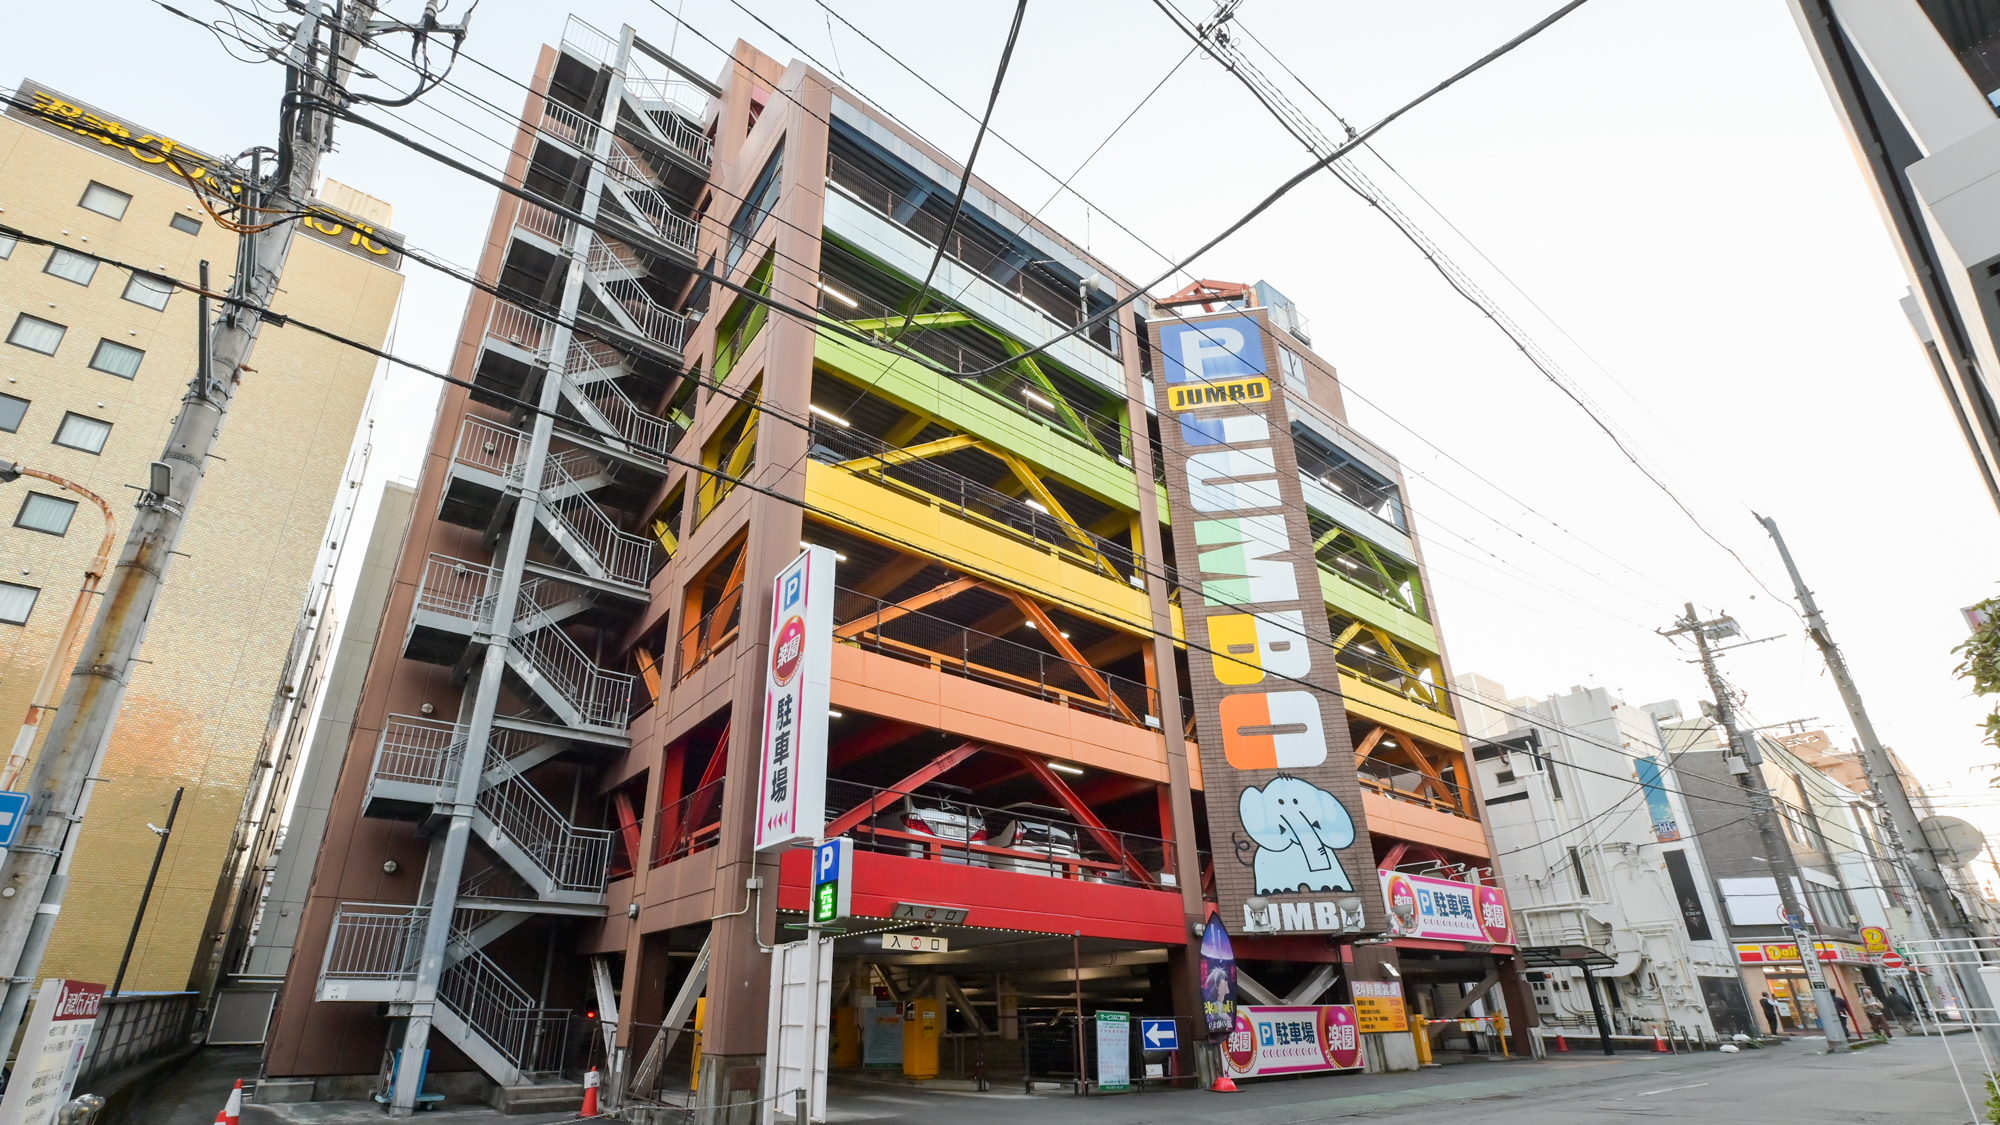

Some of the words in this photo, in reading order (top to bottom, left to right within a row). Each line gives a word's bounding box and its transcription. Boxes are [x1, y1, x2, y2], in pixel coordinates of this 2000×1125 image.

[1179, 327, 1244, 380] P
[1175, 382, 1265, 407] JUMBO
[786, 577, 799, 606] P
[1179, 412, 1328, 770] JUMBO
[776, 633, 801, 670] 楽園
[771, 693, 793, 803] 駐車場
[820, 846, 834, 880] P
[1421, 891, 1431, 914] P
[1433, 891, 1473, 920] 駐車場
[1482, 902, 1506, 929] 楽園
[1766, 945, 1799, 960] Dail
[1867, 944, 1888, 952] Daily
[1355, 984, 1399, 997] 24時間営業
[1228, 1031, 1252, 1052] 楽園
[1261, 1025, 1271, 1044] P
[1275, 1022, 1315, 1045] 駐車場
[1328, 1024, 1356, 1051] 楽園
